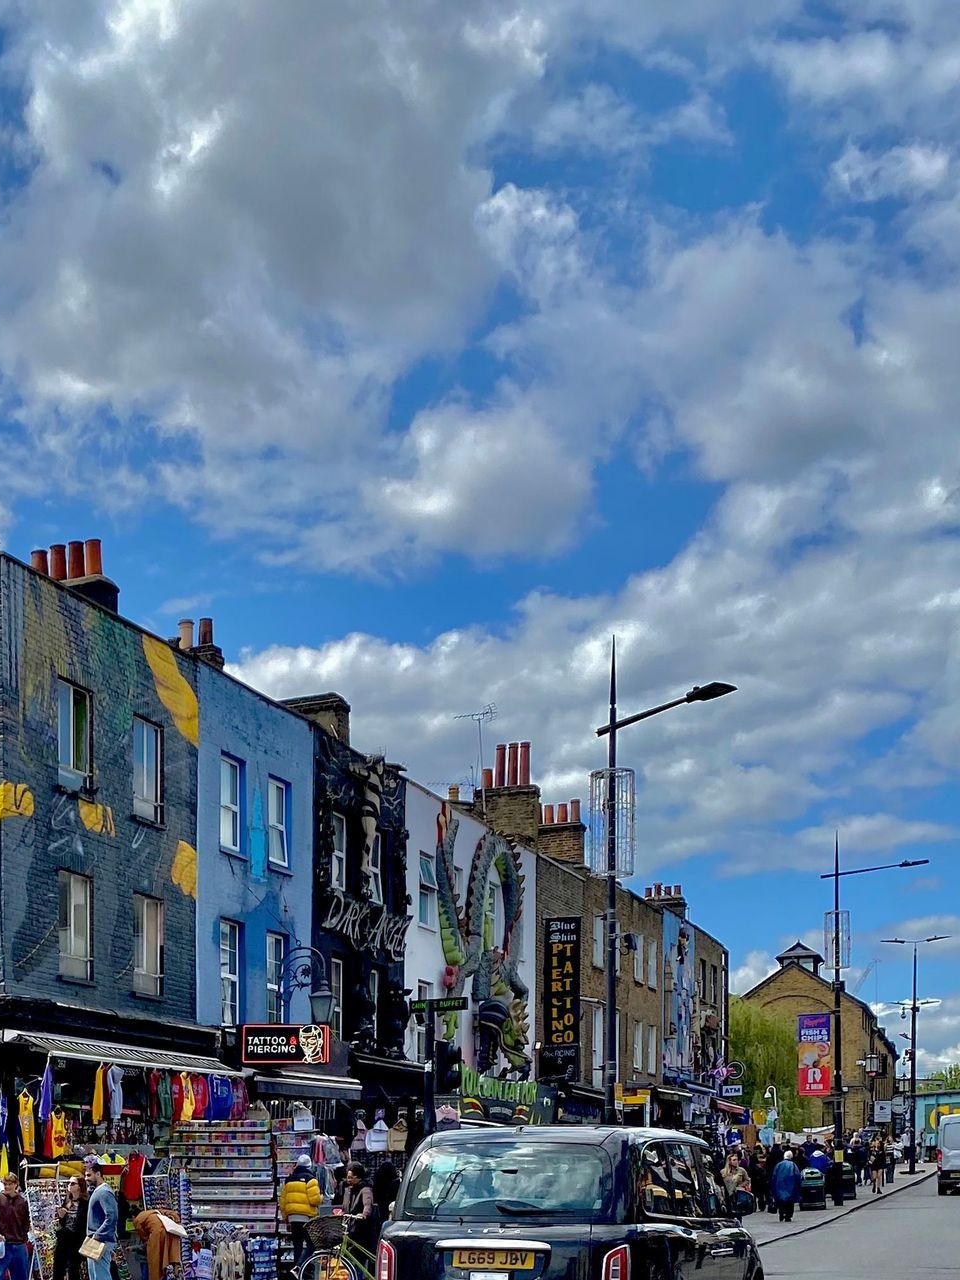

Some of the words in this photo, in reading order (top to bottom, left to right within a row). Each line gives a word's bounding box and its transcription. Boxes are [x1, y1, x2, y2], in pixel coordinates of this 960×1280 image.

[549, 921, 576, 931] Blue
[563, 944, 574, 1043] TATTOO
[247, 1036, 287, 1045] TATTOO
[289, 1036, 297, 1045] &
[247, 1045, 296, 1053] PIERCING
[458, 1252, 495, 1264] LG69
